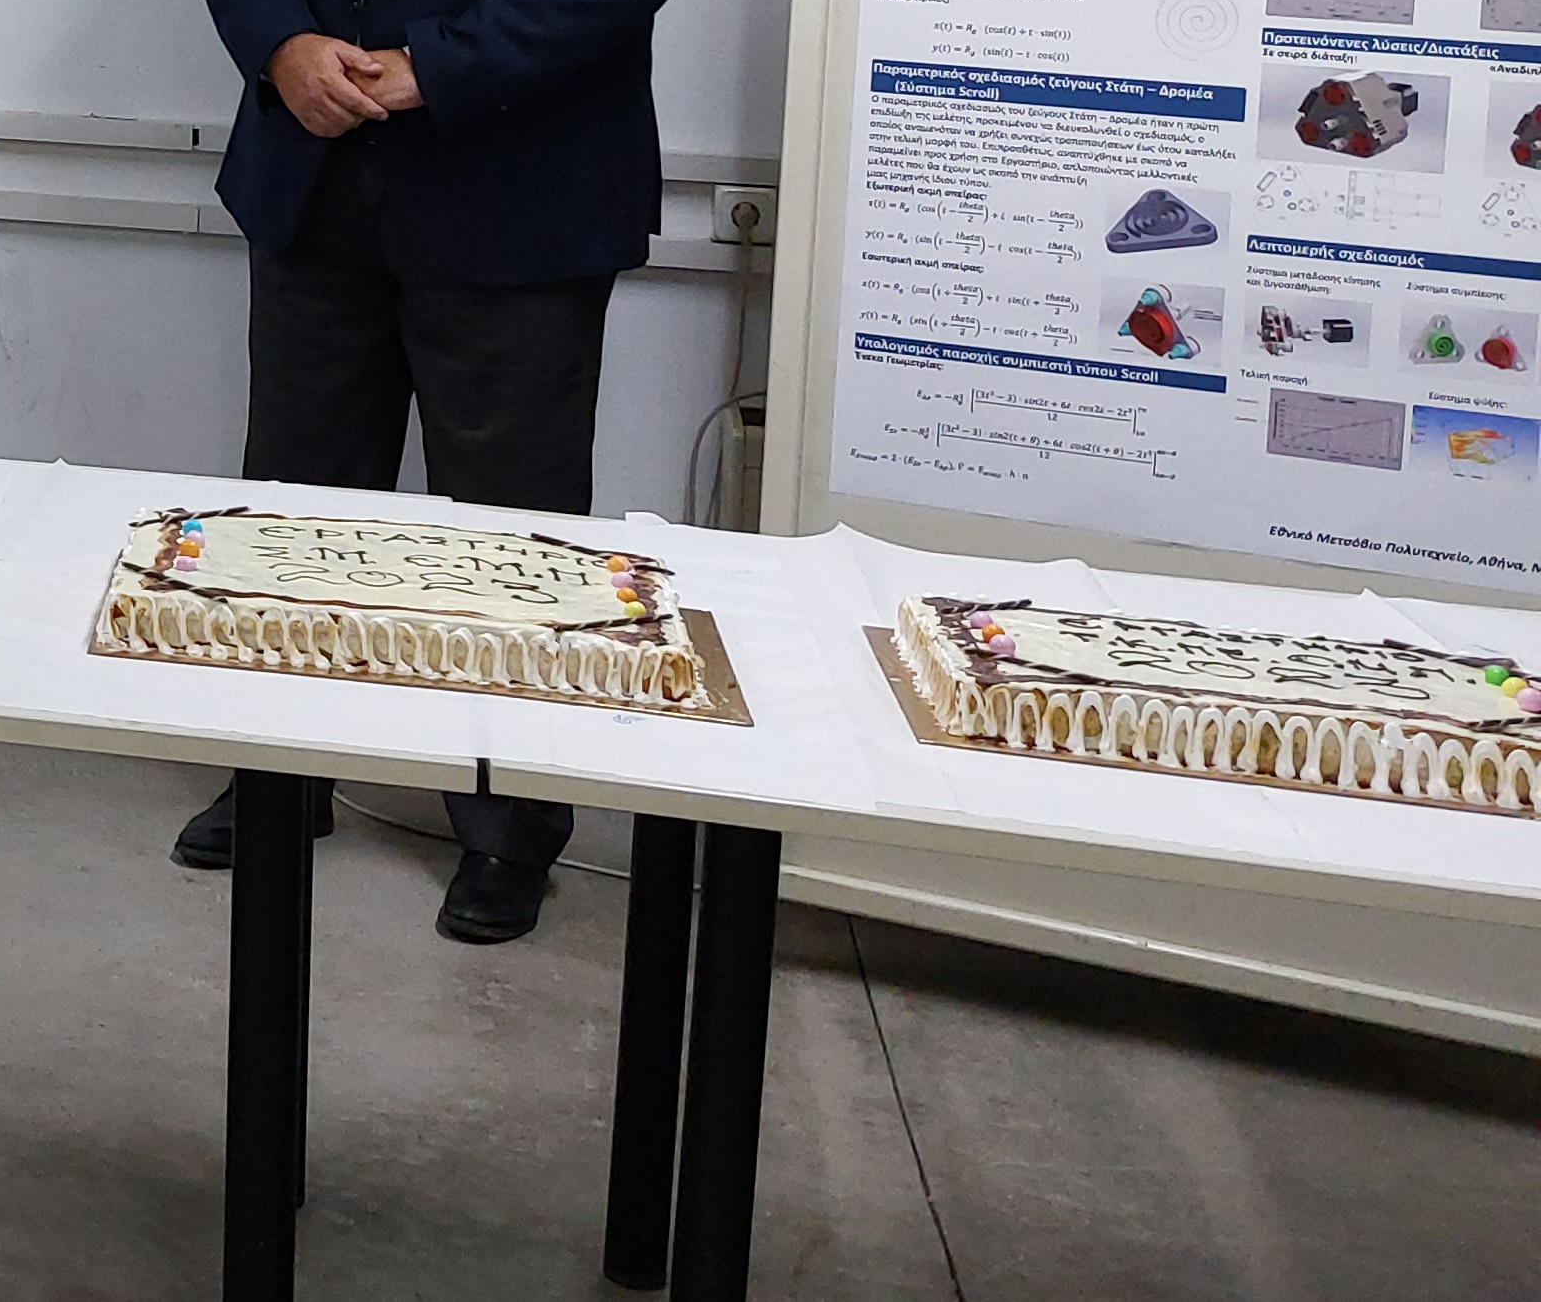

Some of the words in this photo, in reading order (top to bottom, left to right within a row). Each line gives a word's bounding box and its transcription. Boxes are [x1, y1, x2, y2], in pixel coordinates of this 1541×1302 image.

[873, 63, 966, 81] Παραμετρικός
[969, 72, 1046, 88] σχεδιασμός
[1049, 74, 1103, 92] ζεύγους
[1105, 80, 1144, 97] Στάτη
[1159, 87, 1214, 102] Δρομέα
[895, 81, 956, 97] (Σύστημα
[958, 86, 1000, 100] Scroll)
[1249, 240, 1336, 259] Λεπτομερής
[1339, 248, 1425, 268] σχεδιασμός
[856, 337, 940, 356] Υπολογισμός
[943, 348, 1000, 367] παροχής
[1002, 354, 1072, 374] συμπιεστή
[1076, 363, 1118, 378] τύπου
[1120, 368, 1160, 383] Scroll
[1269, 526, 1313, 540] Εθνικό
[1316, 533, 1382, 550] Μετσόβιο
[1385, 542, 1474, 564] Πολυτεχνείο,
[1477, 556, 1527, 572] Αθήνα,
[268, 563, 560, 604] 2023
[1108, 651, 1430, 699] 2023
